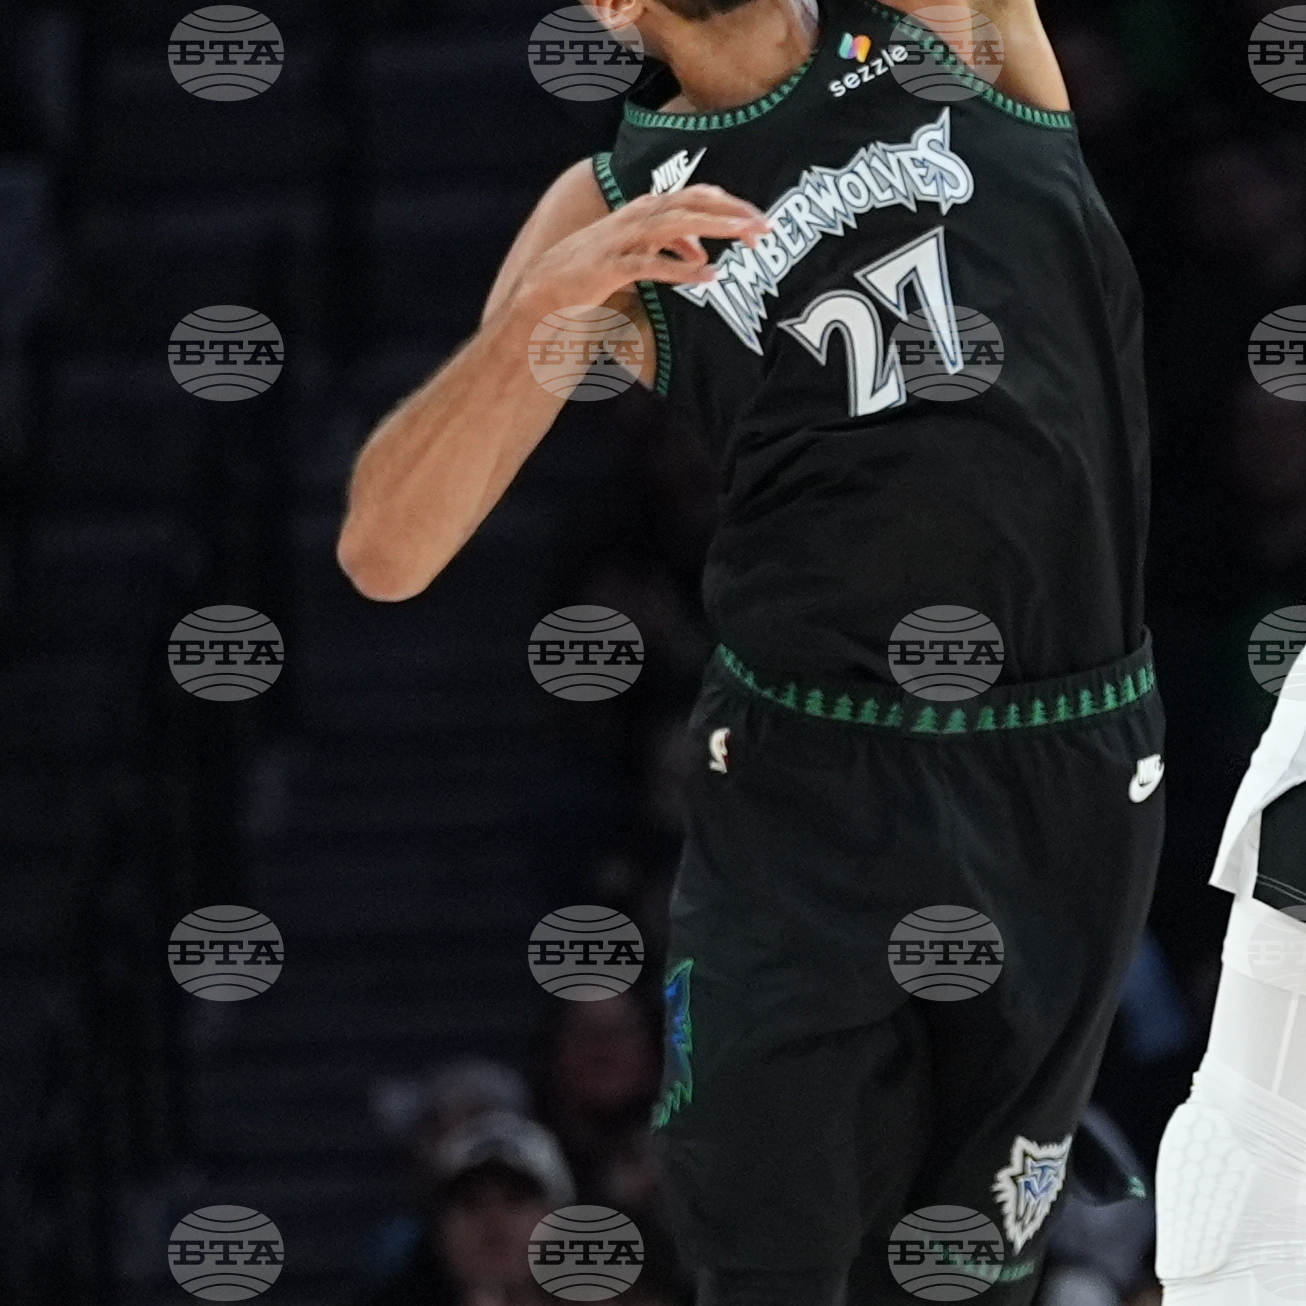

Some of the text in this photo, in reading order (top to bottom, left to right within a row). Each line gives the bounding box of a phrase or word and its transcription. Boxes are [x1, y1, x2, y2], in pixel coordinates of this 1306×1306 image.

[828, 45, 909, 98] sezzle
[651, 149, 690, 195] NIKE
[673, 106, 974, 357] TIMBERWOLVES
[776, 225, 965, 418] 27
